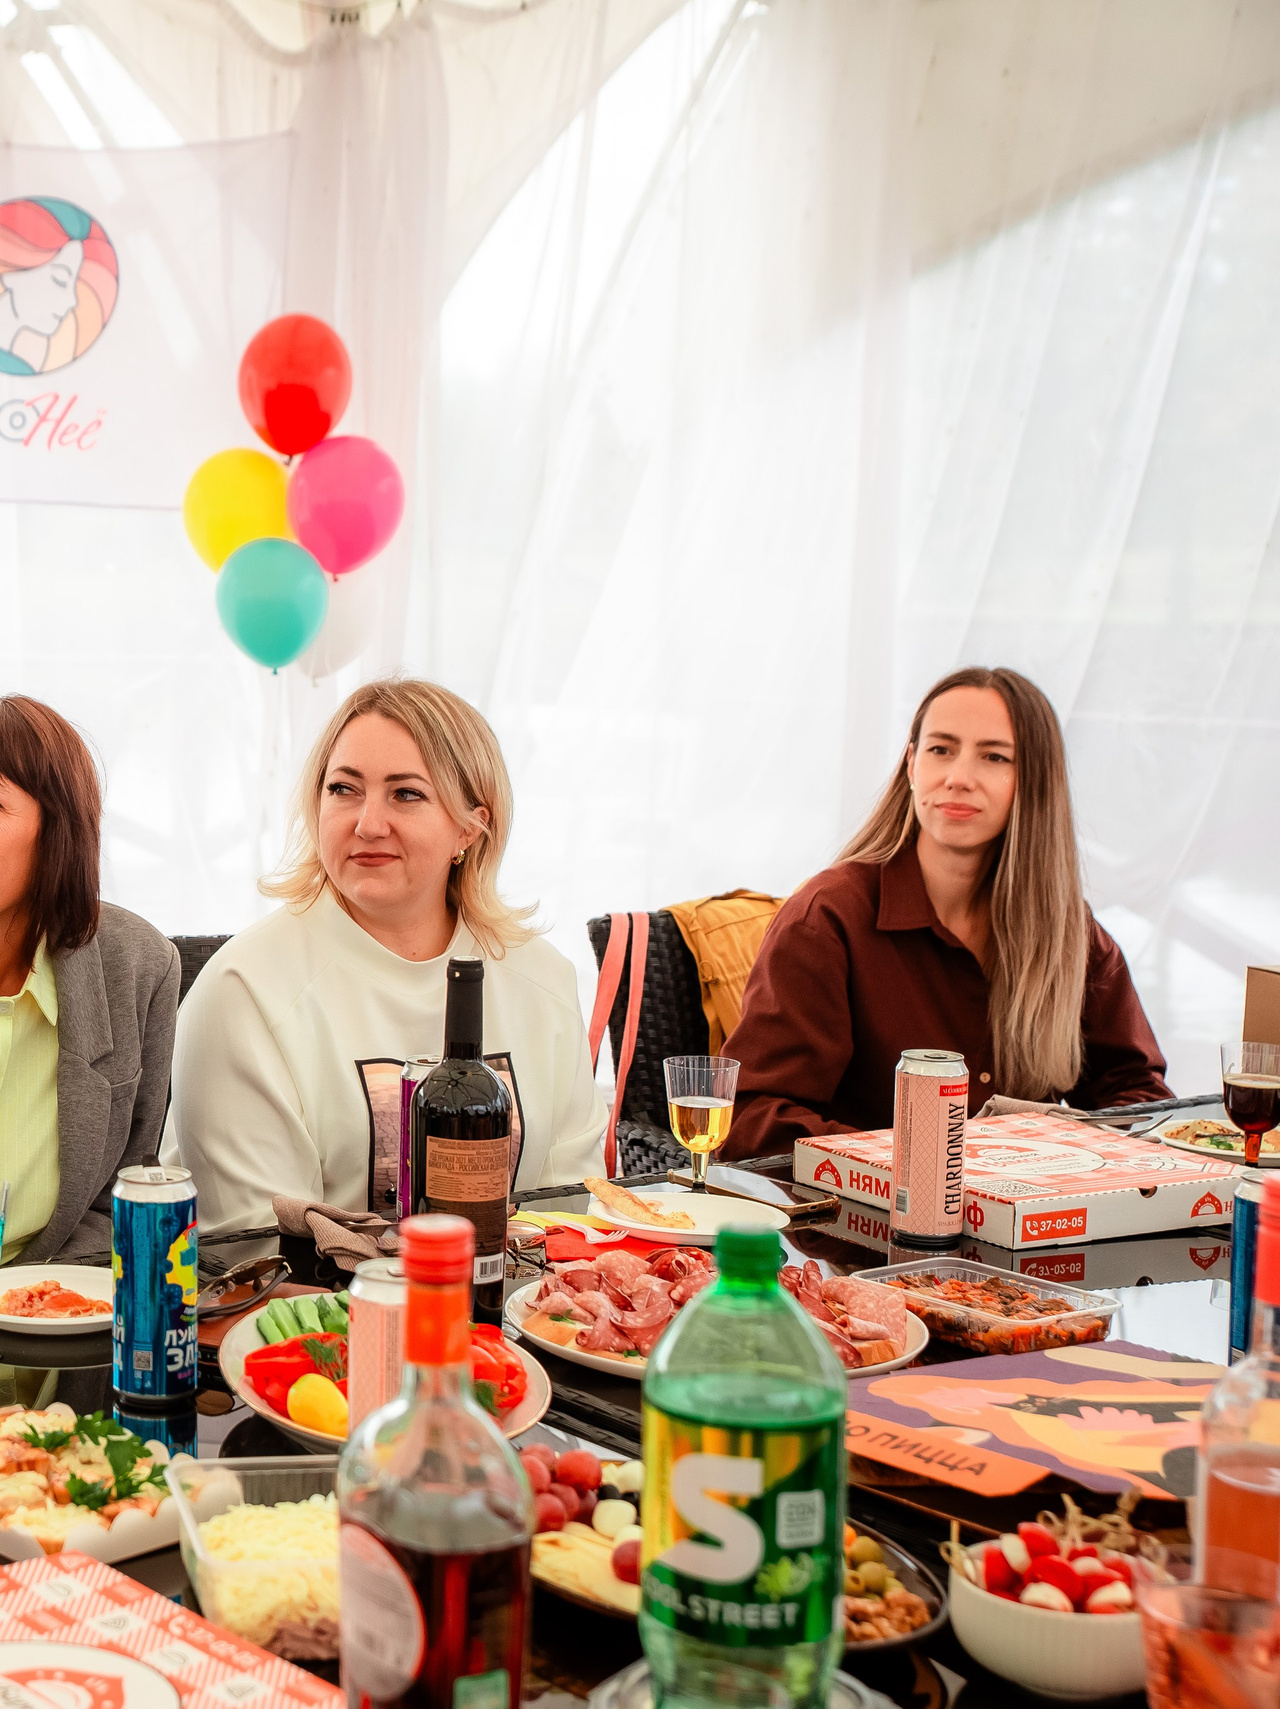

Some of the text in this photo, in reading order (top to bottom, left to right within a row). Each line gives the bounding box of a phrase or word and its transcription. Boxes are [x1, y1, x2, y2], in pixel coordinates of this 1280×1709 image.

[944, 1103, 965, 1215] CHARDONNAY
[1039, 1216, 1084, 1232] 37-02-05
[868, 1431, 988, 1476] ПИЦЦА
[687, 1594, 801, 1629] STREET
